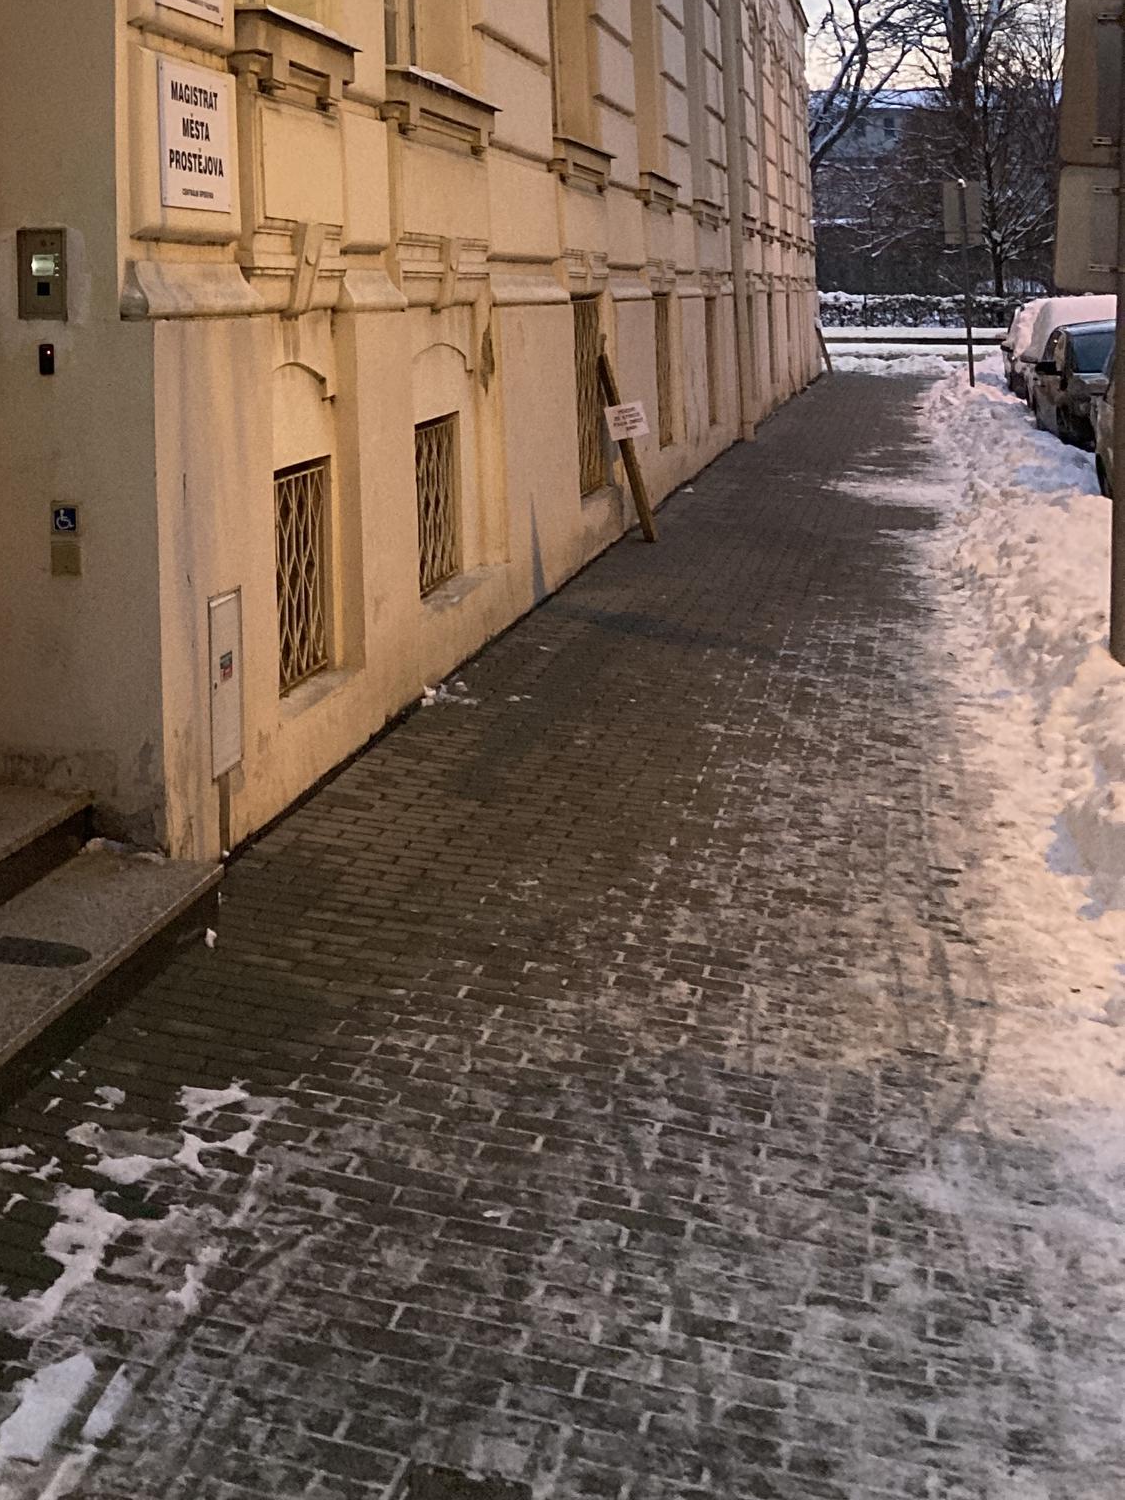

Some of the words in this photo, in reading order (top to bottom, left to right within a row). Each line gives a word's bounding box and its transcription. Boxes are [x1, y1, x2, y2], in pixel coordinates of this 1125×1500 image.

[170, 80, 218, 111] MAGISTRÁT
[182, 113, 211, 143] MĚSTA
[168, 147, 224, 178] PROSTĚJOVA
